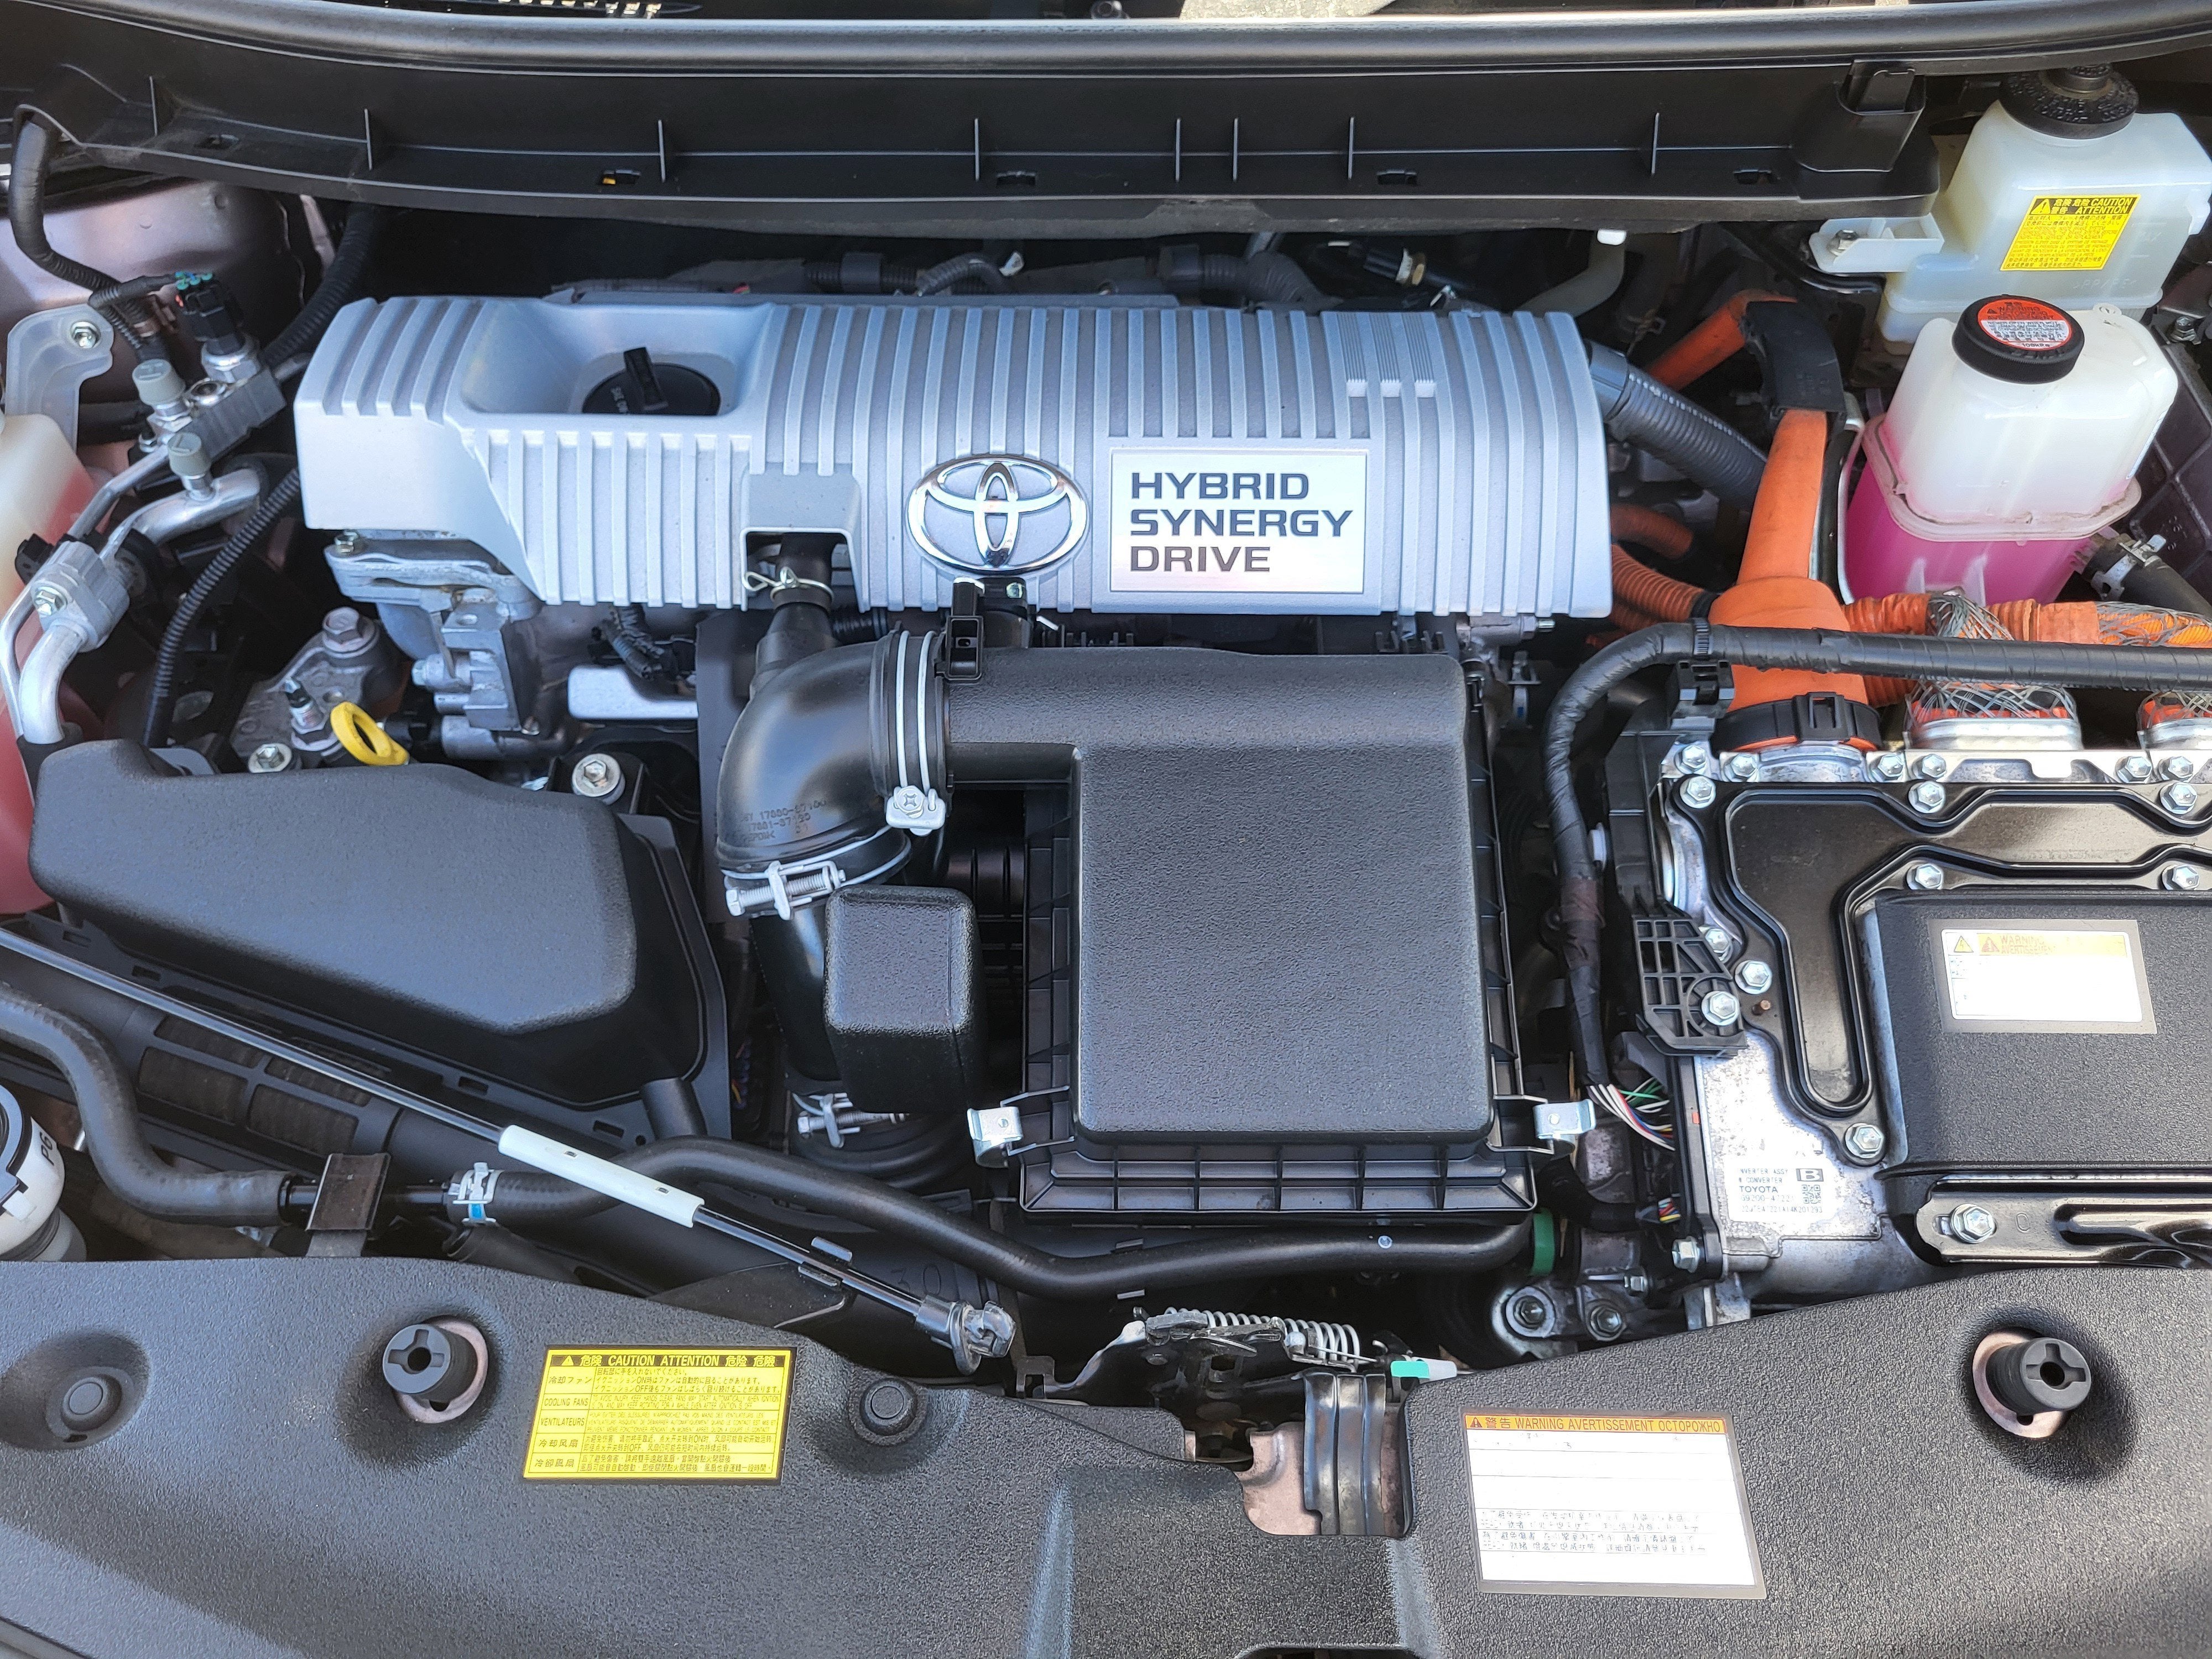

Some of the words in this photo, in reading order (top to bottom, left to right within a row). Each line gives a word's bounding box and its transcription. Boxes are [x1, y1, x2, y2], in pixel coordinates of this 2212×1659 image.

[2091, 198, 2133, 206] CAUTION
[2075, 206, 2128, 215] ATTENTION
[1132, 472, 1309, 499] HYBRID
[1130, 509, 1353, 536] SYNERGY
[1130, 546, 1271, 572] DRIVE
[580, 1355, 602, 1366] 危険
[608, 1355, 655, 1366] CAUTION
[660, 1355, 719, 1366] ATTENTION
[725, 1355, 748, 1366] 危险
[548, 1376, 592, 1385] 冷却ファン
[544, 1398, 570, 1407] COOLING
[573, 1398, 588, 1407] FANS
[540, 1417, 585, 1427] VENTILATEURS
[1485, 1416, 1511, 1429] 警告
[1515, 1417, 1564, 1430] WARNING
[1568, 1418, 1654, 1432] AVERTISSEMENT
[1658, 1420, 1721, 1433] ОСТОРОЖНО
[539, 1439, 578, 1448] 冷却风扇
[534, 1459, 575, 1468] 冷卻風扇
